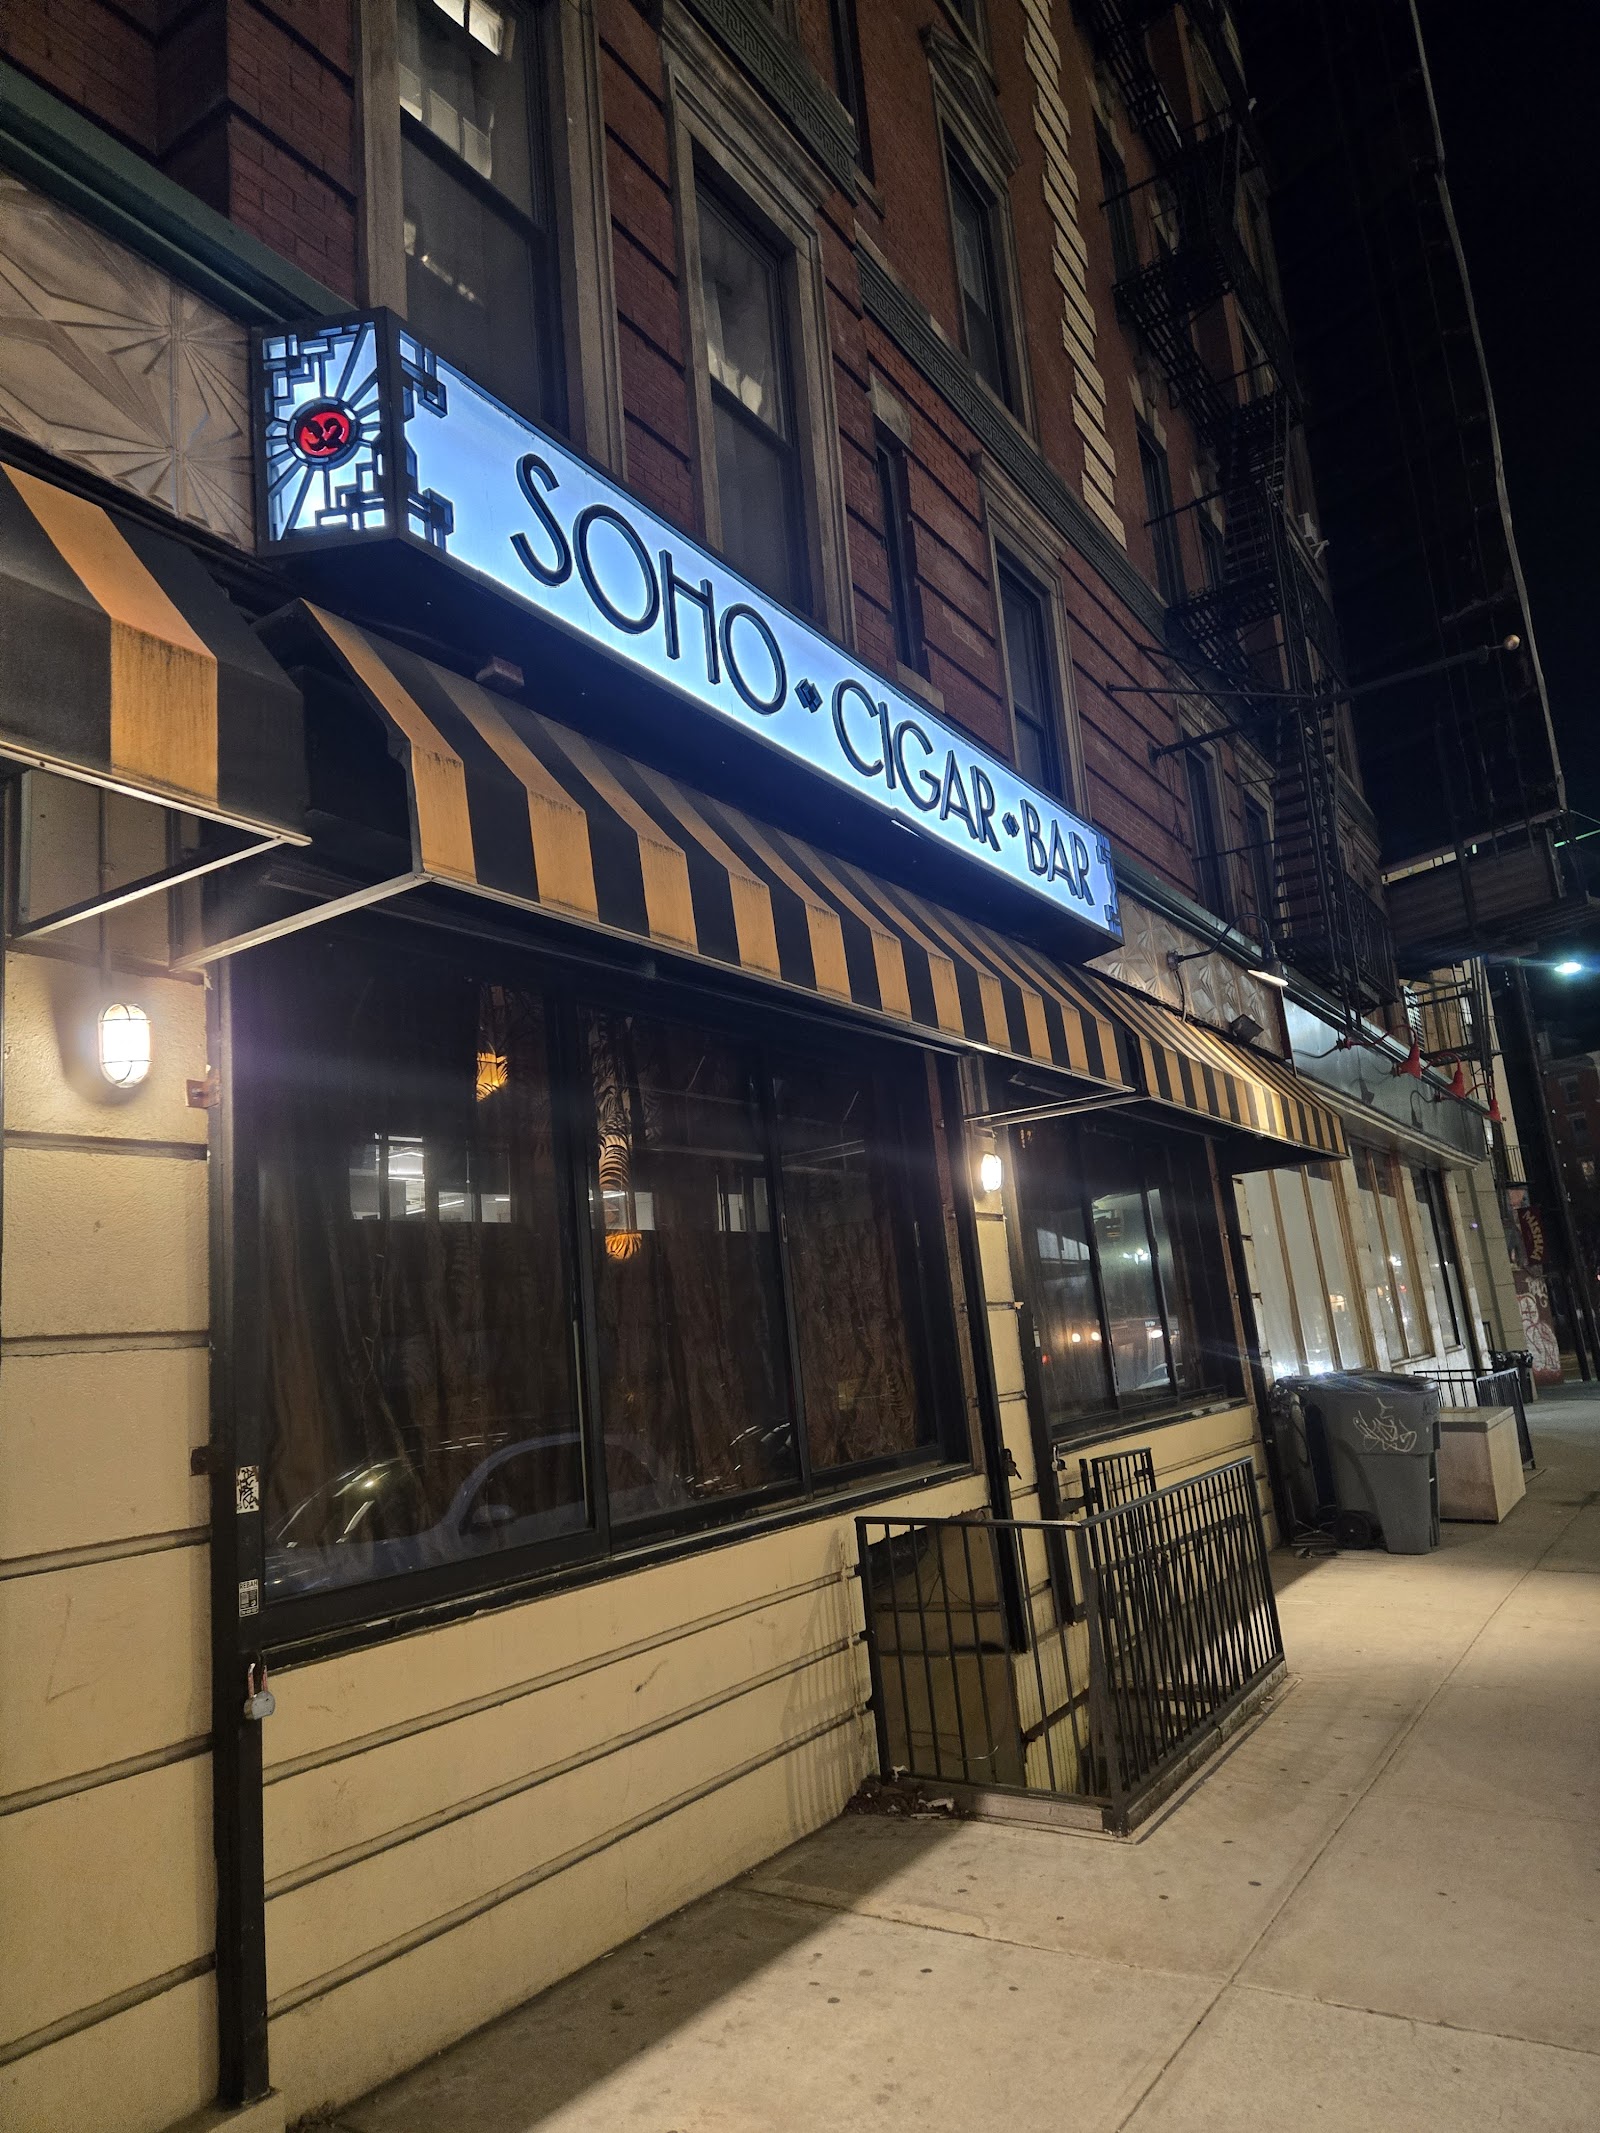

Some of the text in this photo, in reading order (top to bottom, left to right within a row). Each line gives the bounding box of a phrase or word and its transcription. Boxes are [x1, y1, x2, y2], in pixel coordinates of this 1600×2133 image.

[510, 453, 1094, 906] SOHO CIGAR BAR
